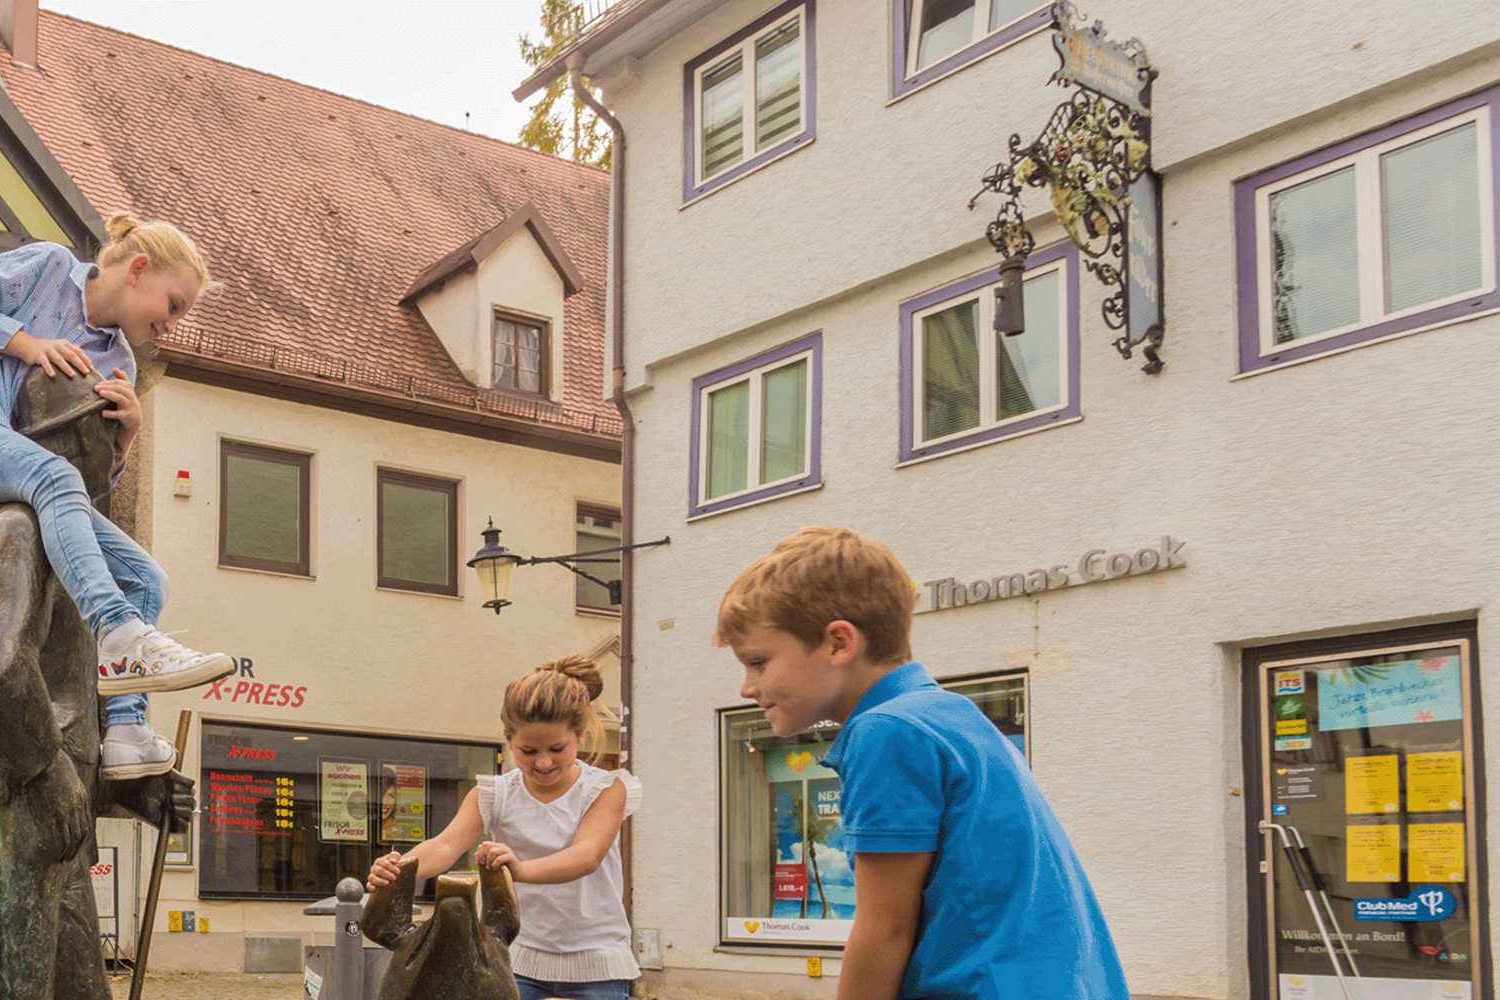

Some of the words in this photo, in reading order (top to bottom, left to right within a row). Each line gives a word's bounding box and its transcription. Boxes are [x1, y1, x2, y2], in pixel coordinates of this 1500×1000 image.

[924, 561, 1068, 612] Thomas
[1078, 535, 1187, 583] Cook
[1278, 677, 1302, 688] ITS
[202, 676, 308, 708] X-PRESS
[226, 746, 277, 760] X-PRESS
[336, 764, 353, 773] Wir
[210, 772, 253, 783] Haarschnitt
[327, 773, 361, 781] suchen
[334, 827, 366, 837] X-PRESS
[762, 922, 791, 931] Thomas
[792, 923, 811, 932] Cook
[1355, 933, 1369, 941] an
[1372, 931, 1405, 942] Bord!
[1439, 953, 1468, 962] AIDA
